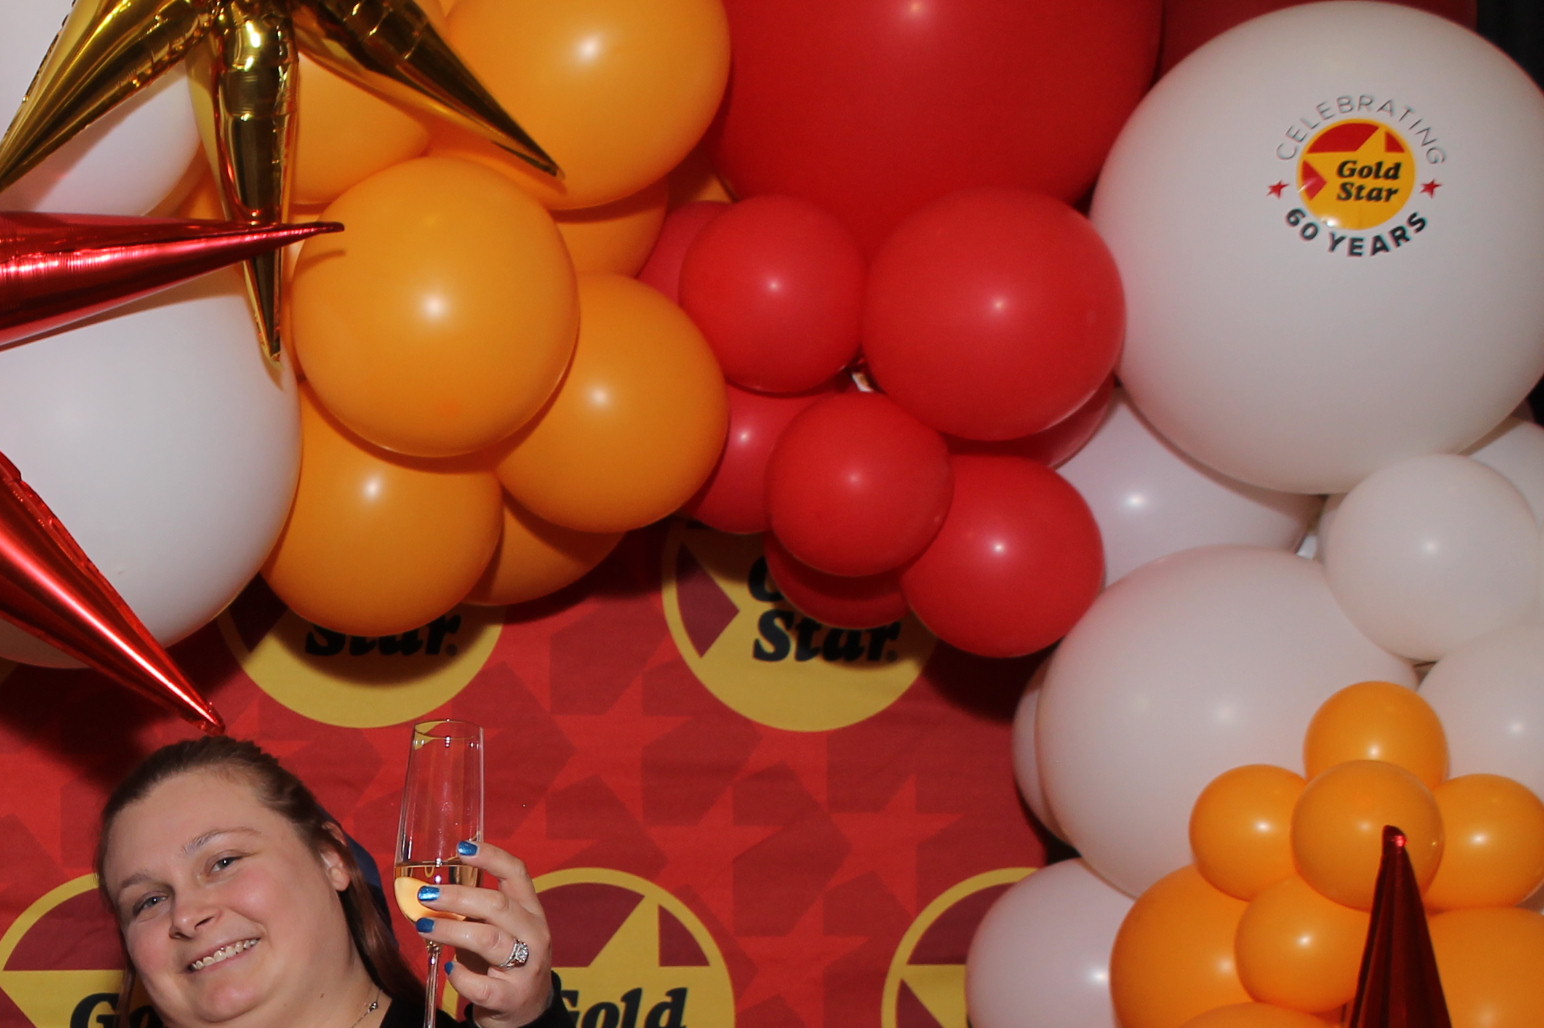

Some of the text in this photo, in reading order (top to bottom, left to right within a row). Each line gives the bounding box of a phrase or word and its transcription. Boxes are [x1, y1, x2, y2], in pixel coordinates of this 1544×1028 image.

[1276, 94, 1446, 165] CELEBRATING
[1336, 160, 1401, 180] Gold
[1336, 182, 1399, 202] Star
[1285, 208, 1427, 257] 60 YEARS
